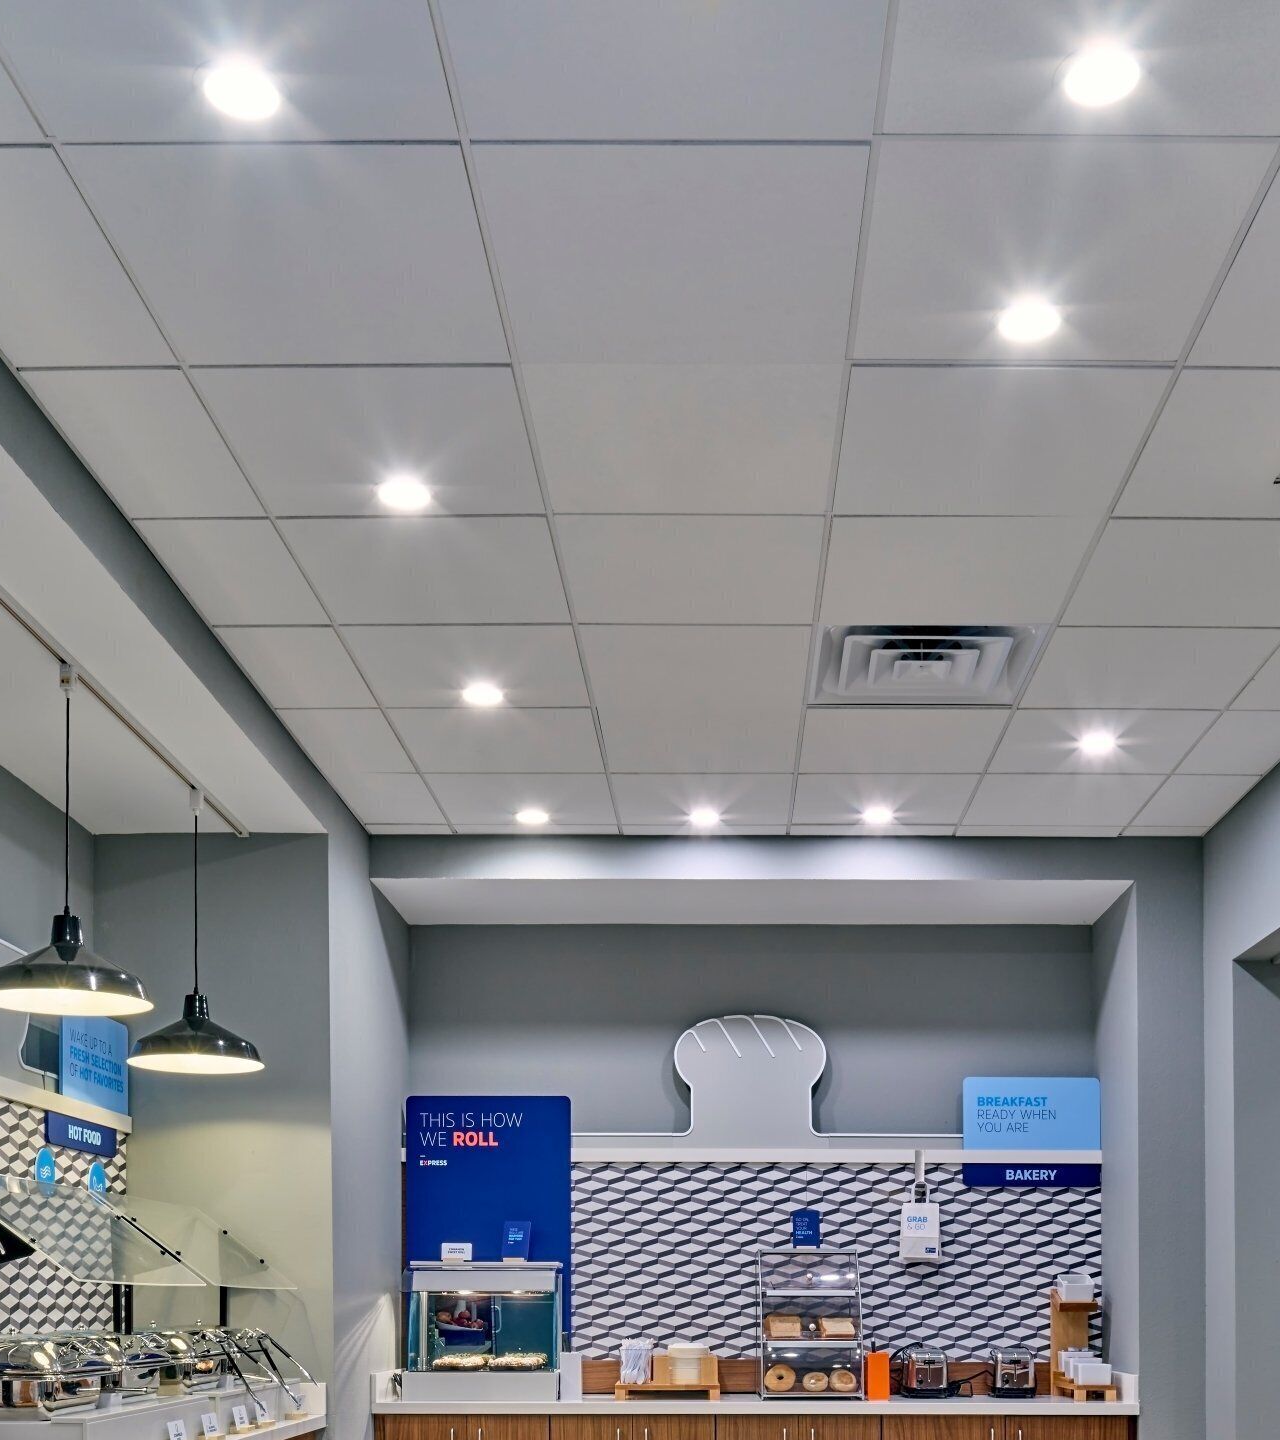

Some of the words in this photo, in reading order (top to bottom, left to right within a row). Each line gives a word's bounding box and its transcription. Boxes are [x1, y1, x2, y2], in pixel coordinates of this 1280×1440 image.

[69, 1027, 88, 1048] WAKE
[90, 1036, 98, 1050] UP
[99, 1039, 107, 1055] TO
[107, 1044, 113, 1057] A
[69, 1045, 91, 1065] FRESH
[91, 1054, 122, 1077] SELECTION
[69, 1062, 78, 1078] OF
[79, 1067, 92, 1081] HOT
[93, 1071, 124, 1093] FAVORITES
[977, 1096, 1048, 1107] BREAKFAST
[419, 1112, 455, 1128] THIS
[461, 1112, 475, 1128] IS
[481, 1112, 523, 1128] HOW
[977, 1109, 1016, 1120] READY
[1020, 1109, 1056, 1120] WHEN
[68, 1124, 82, 1141] HOT
[83, 1128, 101, 1146] FOOD
[977, 1122, 1002, 1133] YOU
[1006, 1122, 1029, 1133] ARE
[419, 1131, 447, 1147] WE
[452, 1131, 499, 1147] ROLL
[1005, 1169, 1058, 1181] BAKERY
